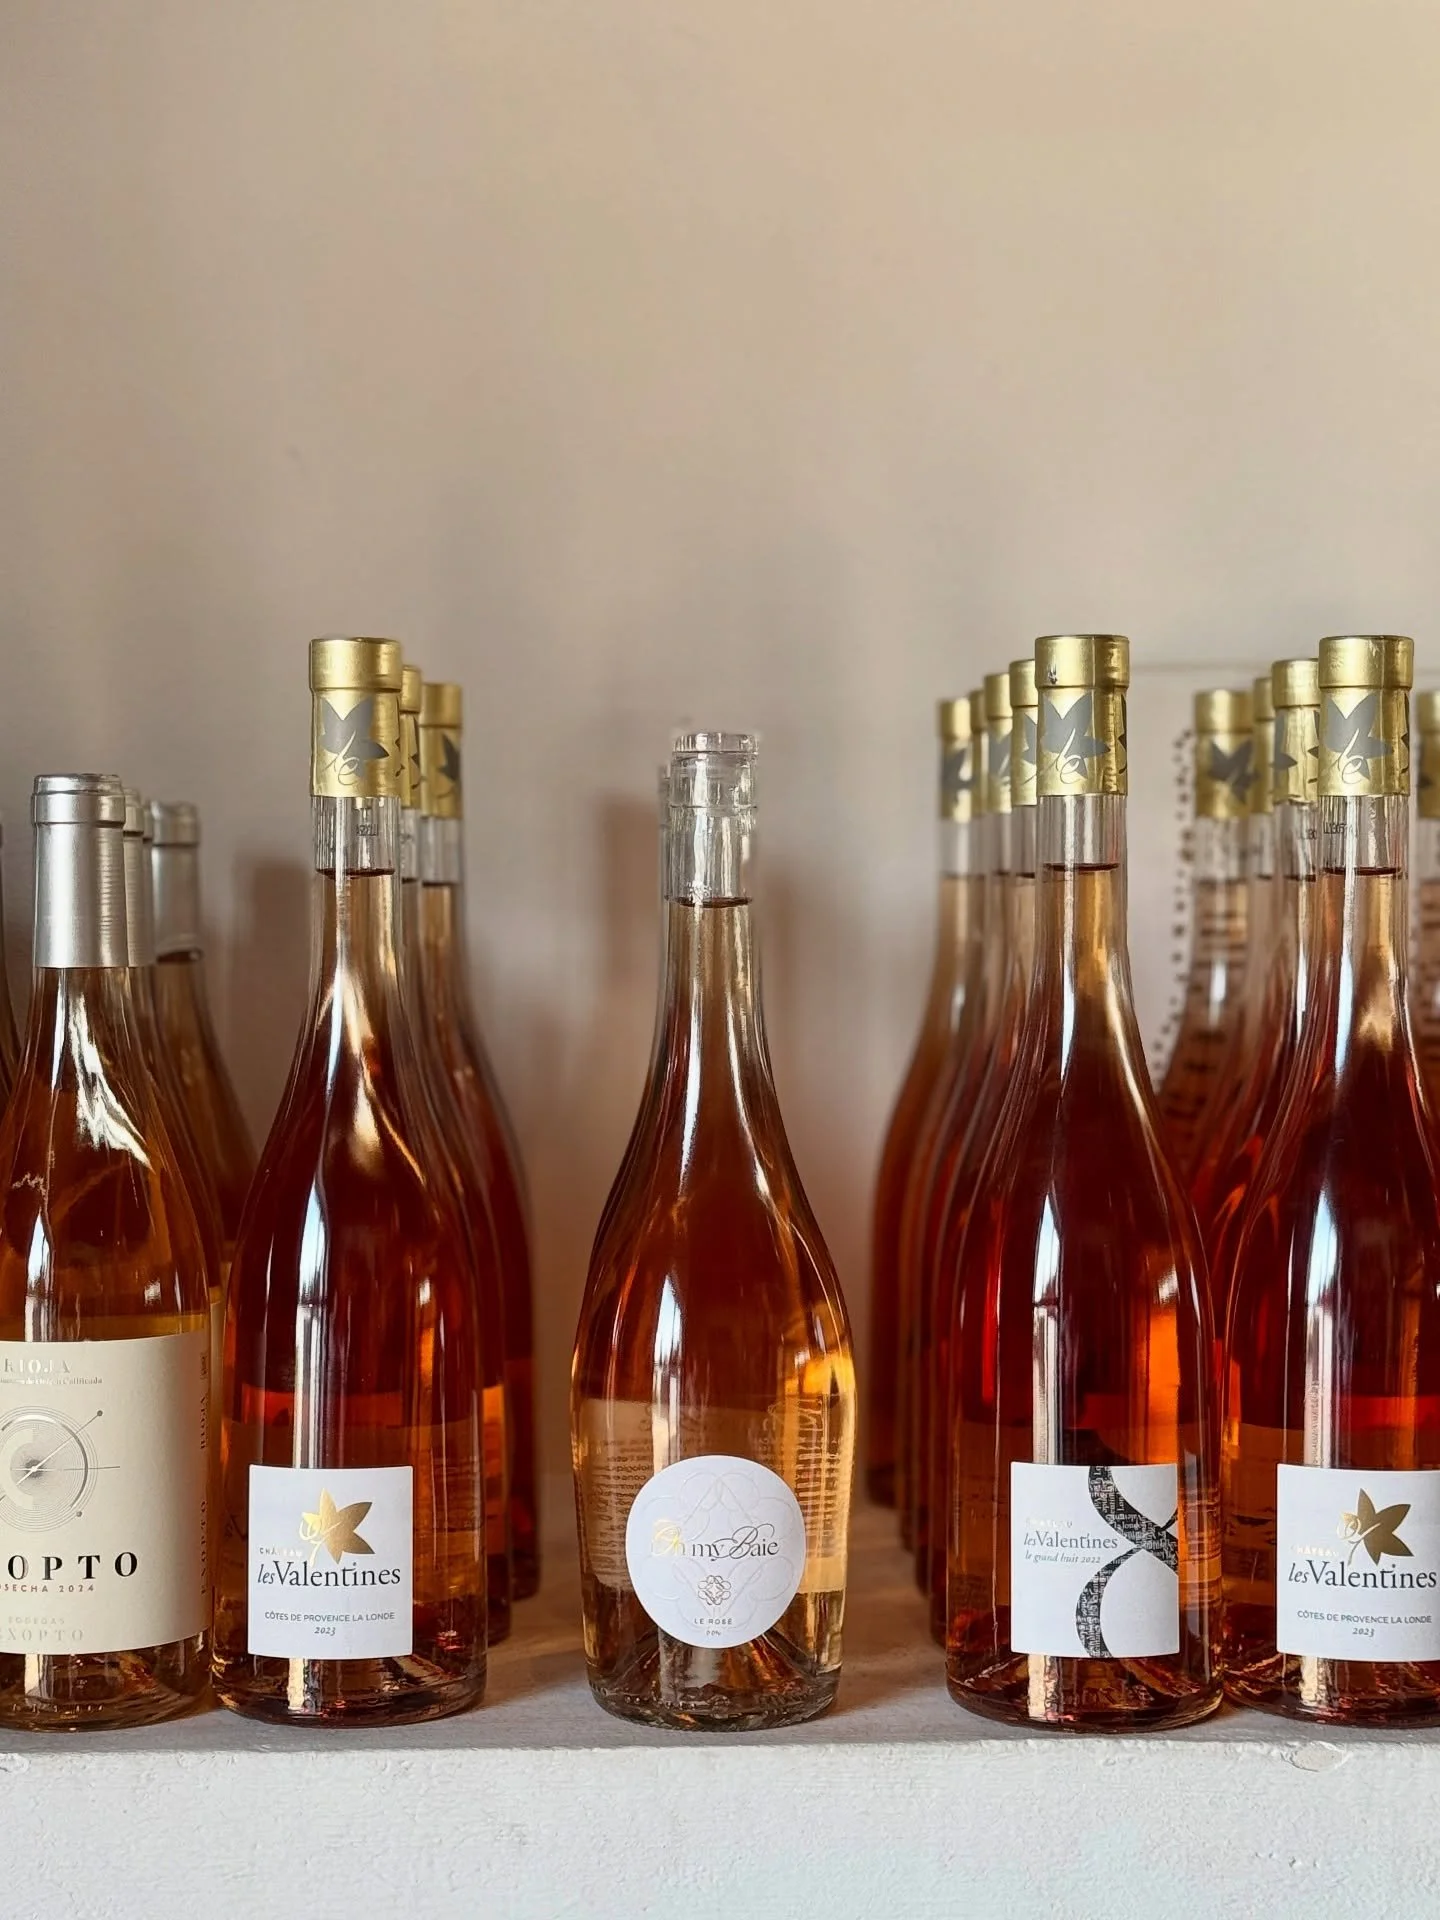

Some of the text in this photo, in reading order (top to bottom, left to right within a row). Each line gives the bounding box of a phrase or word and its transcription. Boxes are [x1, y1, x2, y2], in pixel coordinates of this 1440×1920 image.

[4, 1358, 72, 1374] RIOJA
[692, 1539, 724, 1562] my
[725, 1523, 779, 1559] Baie
[1034, 1552, 1059, 1563] grand
[1081, 1556, 1101, 1564] 2022
[7, 1552, 138, 1581] OPTO
[0, 1583, 94, 1593] SECHA 2024
[265, 1610, 395, 1622] CÔTES DE PROVENCE LA LONDE
[708, 1617, 733, 1625] ROSÉ
[1297, 1610, 1432, 1624] CÔTES DE PROVENCE LA LONDE
[0, 1627, 84, 1642] XOPTO
[314, 1627, 336, 1636] 2023
[1352, 1627, 1375, 1637] 2023
